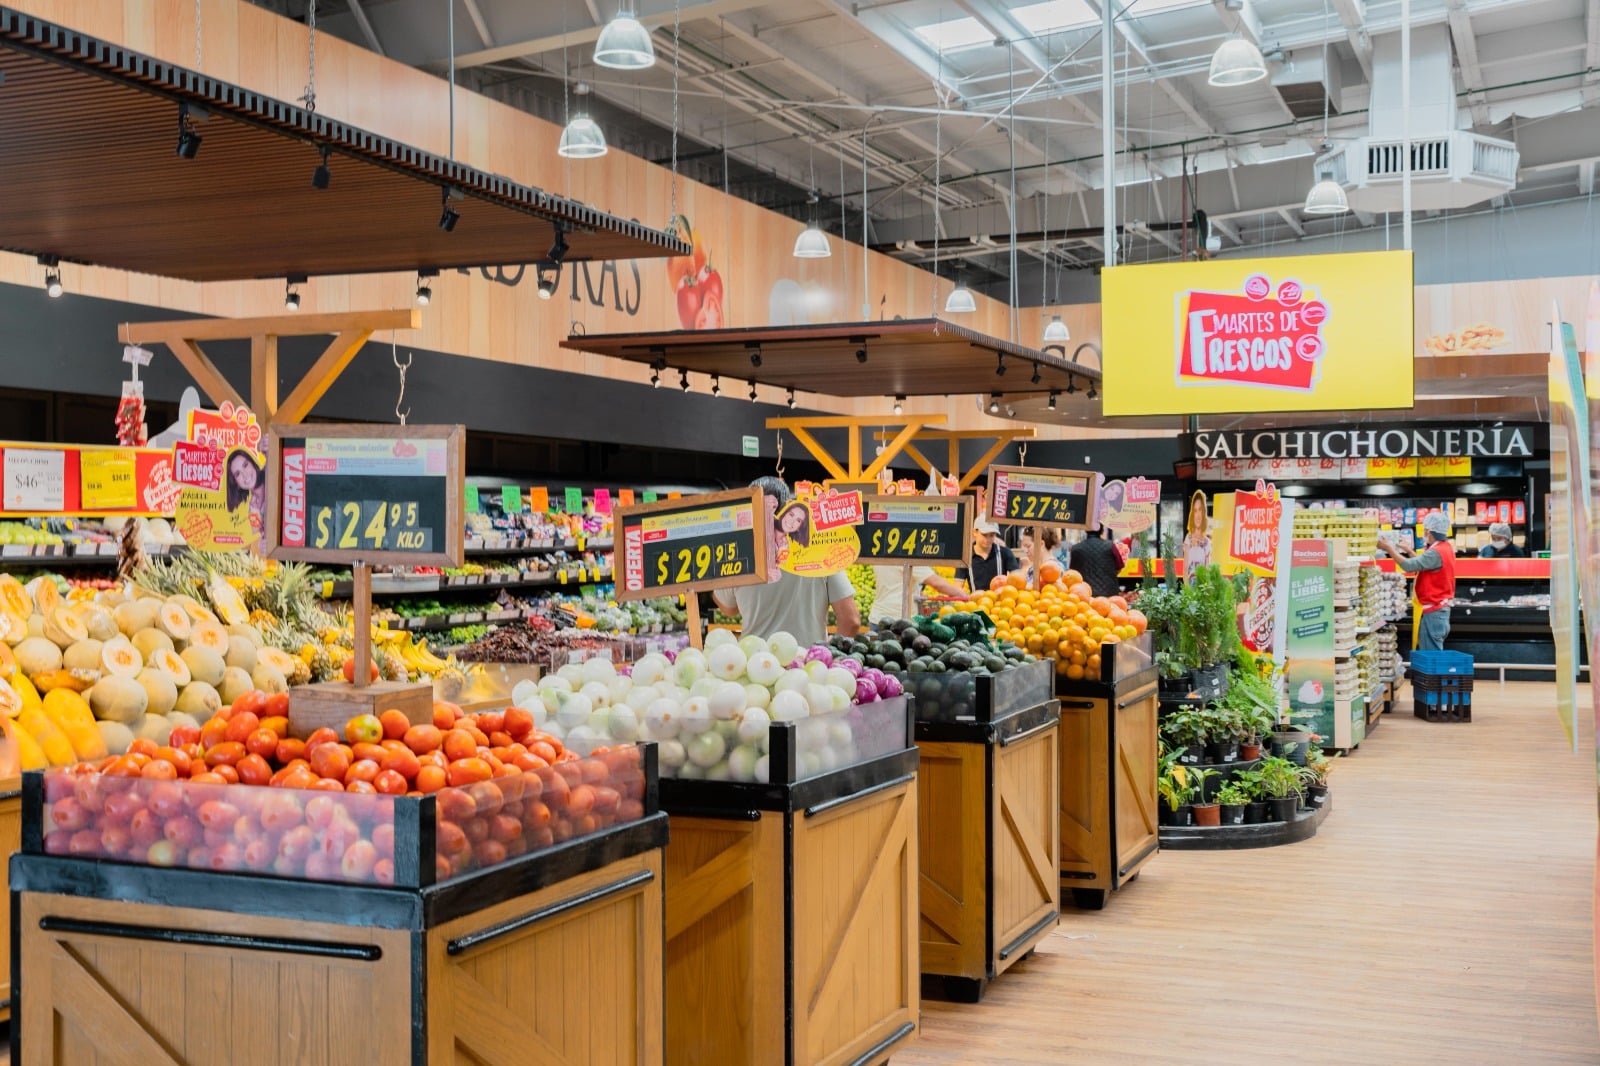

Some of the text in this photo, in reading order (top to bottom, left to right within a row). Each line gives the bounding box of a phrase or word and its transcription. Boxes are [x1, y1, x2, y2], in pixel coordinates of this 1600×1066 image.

[1213, 310, 1300, 335] MARTES DE
[1189, 308, 1294, 375] FRESCOS
[1194, 423, 1532, 459] SALCHICHONERÍA
[176, 448, 214, 482] FRESCOS
[285, 453, 303, 542] OFERTA
[994, 475, 1008, 516] OFERTA
[820, 500, 857, 524] FRESCOS
[1054, 511, 1071, 520] KILO
[396, 531, 425, 549] KILO
[1234, 504, 1271, 555] FRESCOS
[626, 528, 642, 592] OFERTA
[922, 544, 940, 555] KILO
[720, 561, 742, 576] KILO
[1291, 575, 1325, 589] EL MÁS
